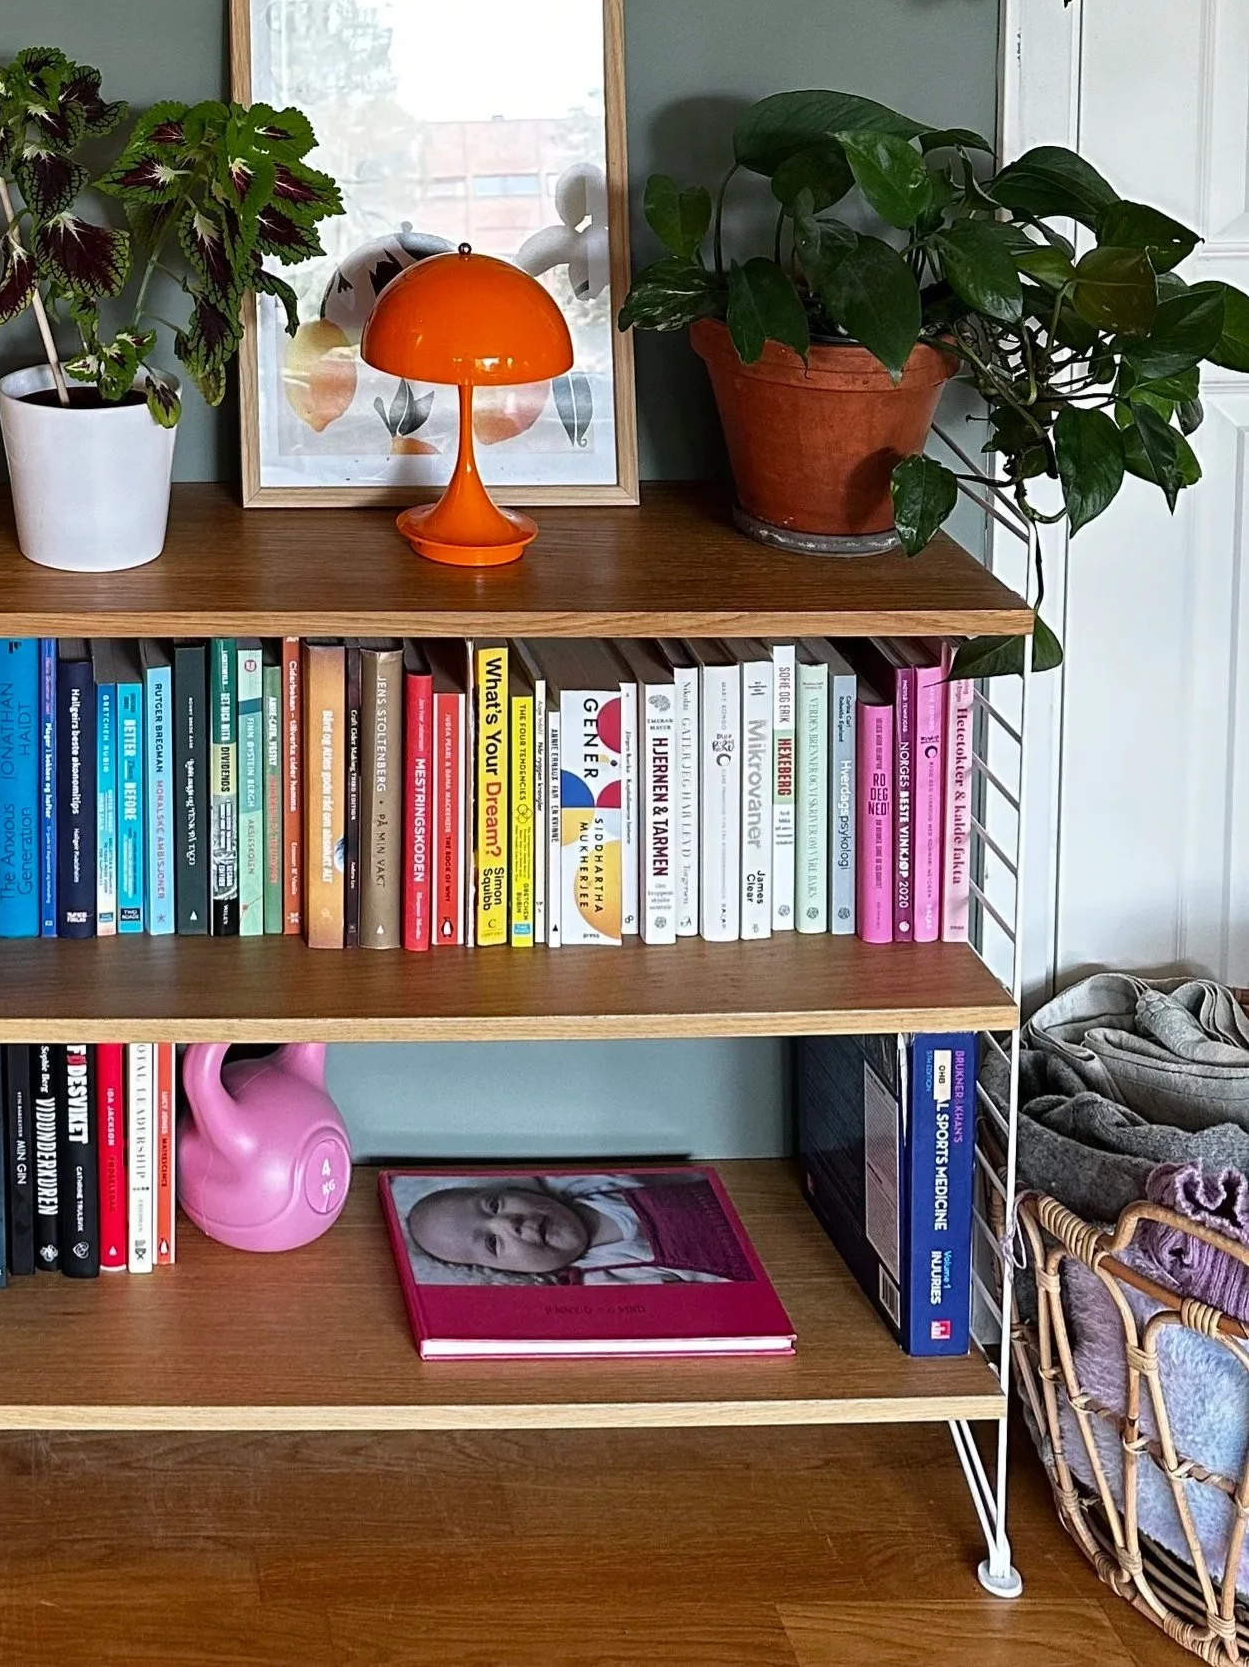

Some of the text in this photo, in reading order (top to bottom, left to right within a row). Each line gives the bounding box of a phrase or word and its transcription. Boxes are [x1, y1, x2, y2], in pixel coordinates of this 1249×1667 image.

[155, 683, 163, 723] RUTGER
[779, 667, 790, 723] SOFIE OG ERIK
[809, 698, 818, 731] VERDEN
[0, 683, 15, 781] JONATHAN
[17, 703, 32, 755] HAIDT
[124, 719, 136, 756] BETTER
[350, 710, 358, 729] Craft
[350, 731, 358, 749] Cider
[551, 729, 559, 750] ANNIE
[584, 698, 599, 779] GENER
[69, 689, 81, 814] Hallgeirs beste økonomitips
[155, 725, 163, 773] BREGMAN
[246, 718, 255, 807] FINN ØYSTEIN BERGH
[269, 741, 277, 766] VESTLY
[289, 757, 297, 779] cider
[349, 751, 358, 771] Making
[485, 657, 502, 857] What's Your Dream?
[778, 738, 791, 795] HEXEBERG
[809, 734, 818, 773] BRENNER
[955, 708, 968, 787] Hetetokter
[220, 747, 230, 792] DIVIDENDS
[376, 675, 388, 887] JENS STOLTENBERG PÅ MIN VAKT
[652, 738, 668, 803] HJERNEN
[681, 764, 693, 788] JEG
[748, 720, 766, 848] Mikrovaner
[809, 775, 818, 785] OG
[873, 774, 886, 787] RO
[124, 782, 136, 820] BEFORE
[322, 710, 334, 882] Bård og Atles gode råd om absolutt ALT
[652, 806, 668, 815] &
[809, 798, 818, 834] SKRIVER
[838, 760, 853, 870] Hverdagspsykologi
[868, 802, 890, 815] NED!
[870, 788, 888, 801] DEG
[955, 791, 966, 800] &
[414, 758, 426, 882] MESTRINGSKODEN
[899, 742, 910, 908] NORGES BESTE VINKJØP 2020
[954, 805, 966, 845] kalde
[0, 804, 15, 901] The Anxious
[17, 808, 32, 894] Generation
[652, 819, 669, 876] TARMEN
[809, 837, 818, 849] OM
[494, 867, 504, 905] Simon
[579, 822, 589, 908] MUKHERJEE
[594, 818, 604, 913] SIDDHARTHA
[953, 848, 966, 884] fakta
[481, 868, 493, 911] Squibb
[746, 874, 756, 902] Clear
[756, 871, 765, 904] James
[67, 1045, 88, 1144] FØDESVIKET
[36, 1046, 58, 1214] Sophie Berg VIDUNDERKUREN
[107, 1106, 115, 1146] JACKSON
[136, 1088, 145, 1178] LEADERSHIP
[936, 1114, 949, 1164] SPORTS
[16, 1140, 27, 1184] MIN GIN
[321, 1158, 331, 1176] 4
[322, 1179, 336, 1195] KG
[934, 1167, 947, 1230] MEDICINE
[930, 1251, 942, 1304] INJURIES
[943, 1251, 952, 1282] Volume
